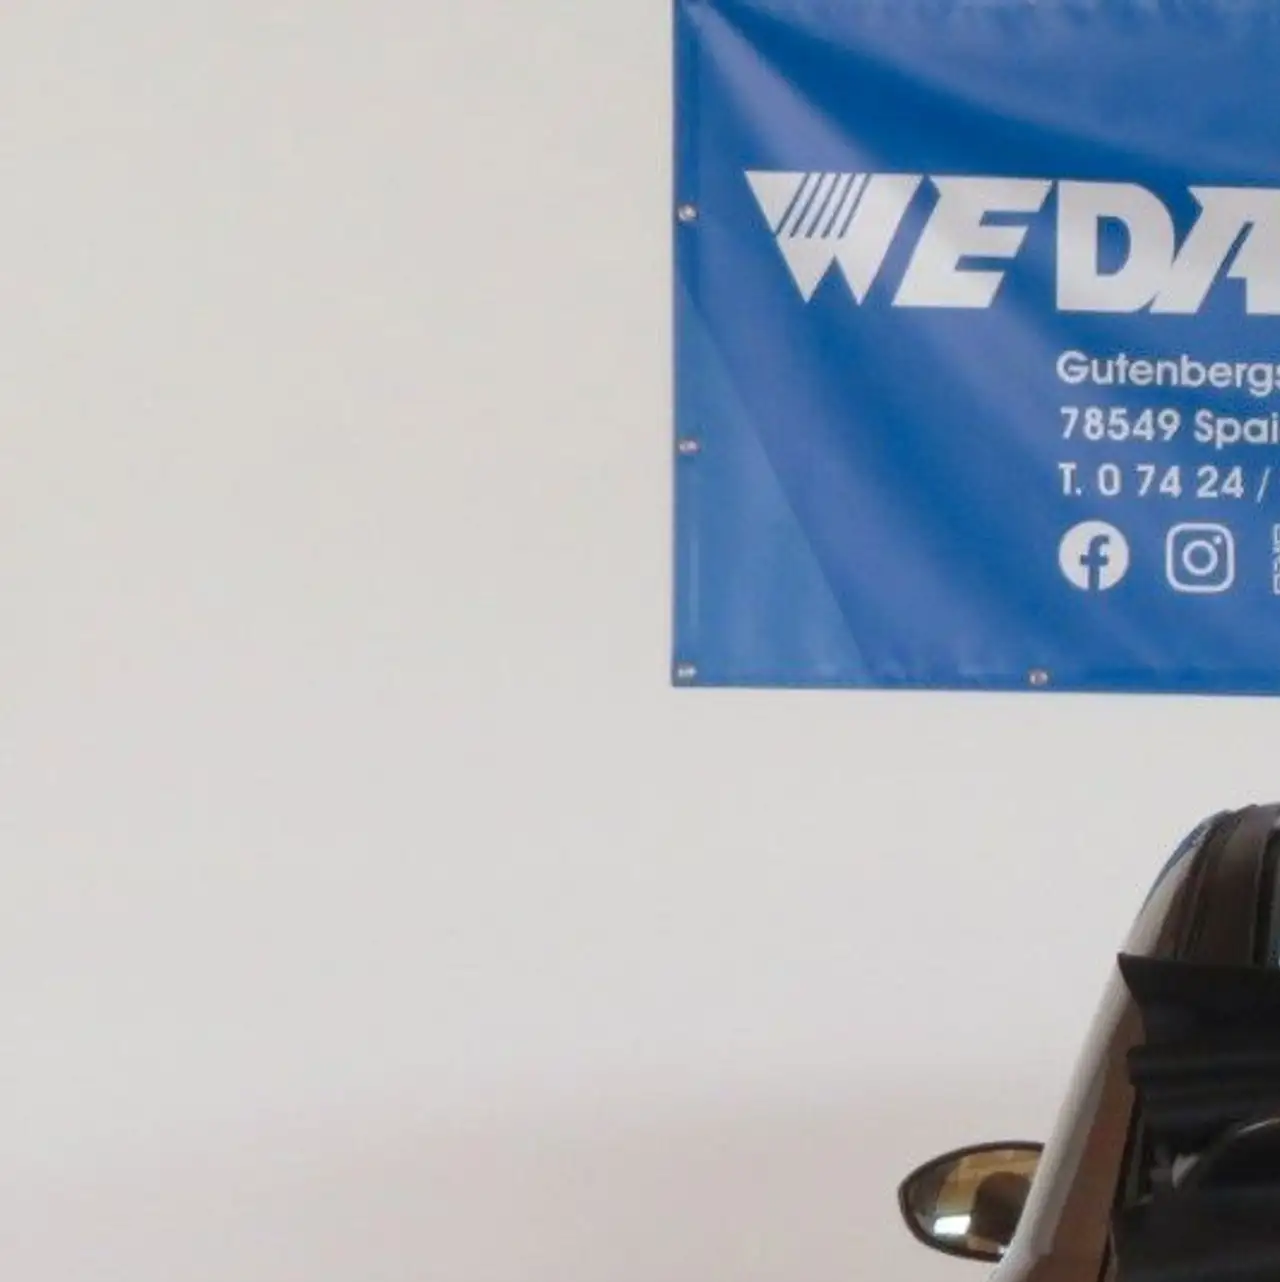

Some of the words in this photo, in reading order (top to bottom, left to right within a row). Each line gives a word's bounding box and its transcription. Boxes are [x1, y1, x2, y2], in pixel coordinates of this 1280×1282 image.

[1059, 406, 1182, 441] 78549
[1058, 462, 1083, 496] T.
[1097, 462, 1122, 496] 0
[1136, 463, 1183, 498] 74
[1196, 465, 1245, 499] 24
